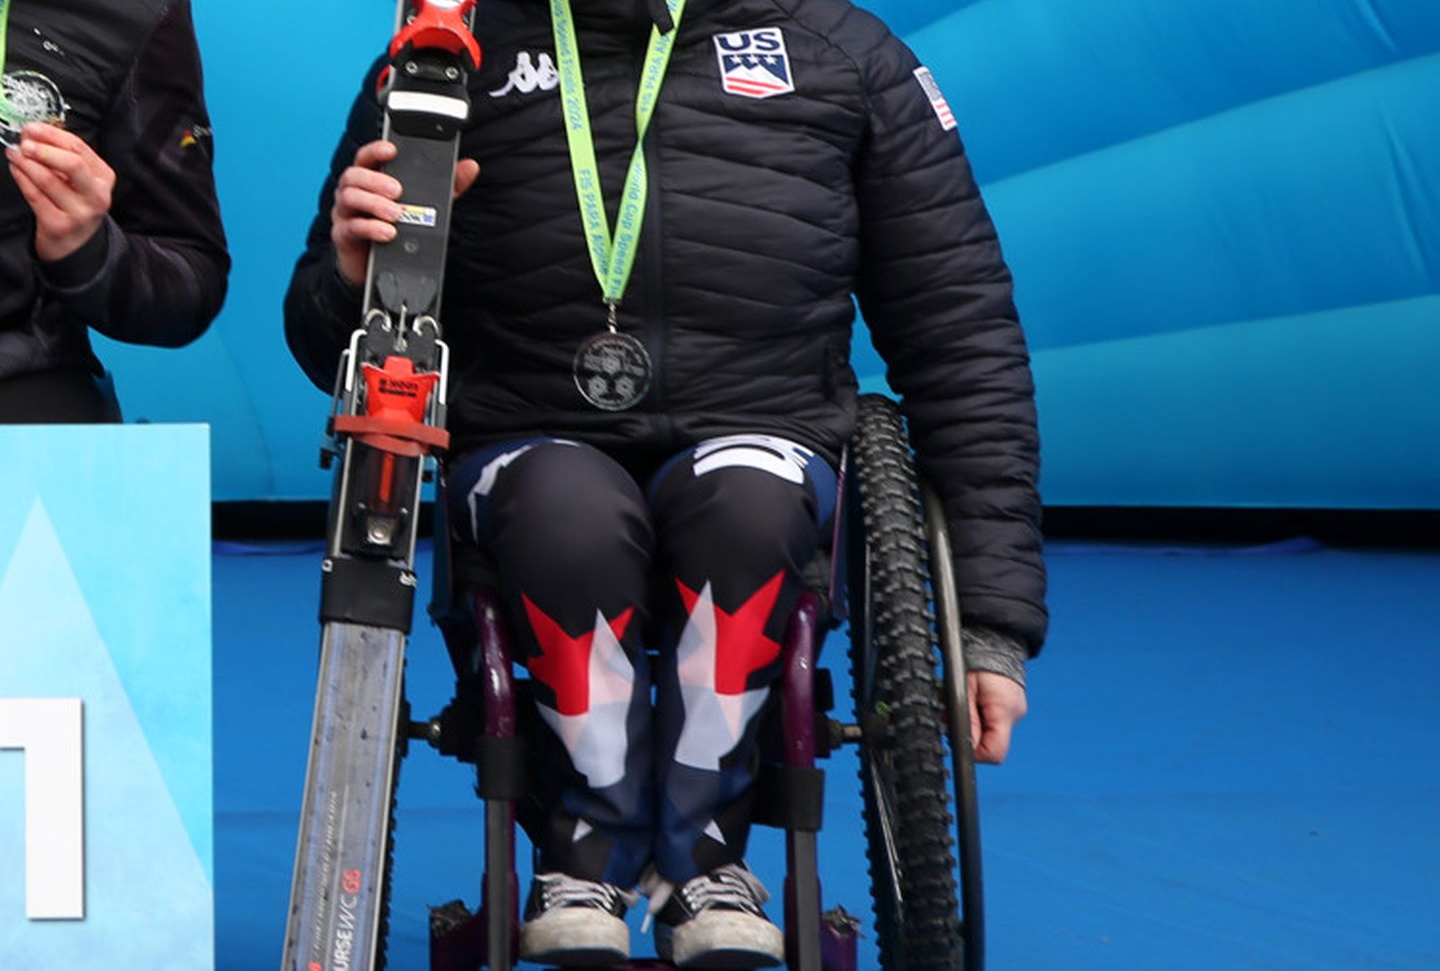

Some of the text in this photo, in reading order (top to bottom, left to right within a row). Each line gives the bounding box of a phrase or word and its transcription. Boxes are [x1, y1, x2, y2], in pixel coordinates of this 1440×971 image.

[718, 31, 781, 51] US
[621, 203, 639, 231] Cup
[614, 233, 633, 275] Speed
